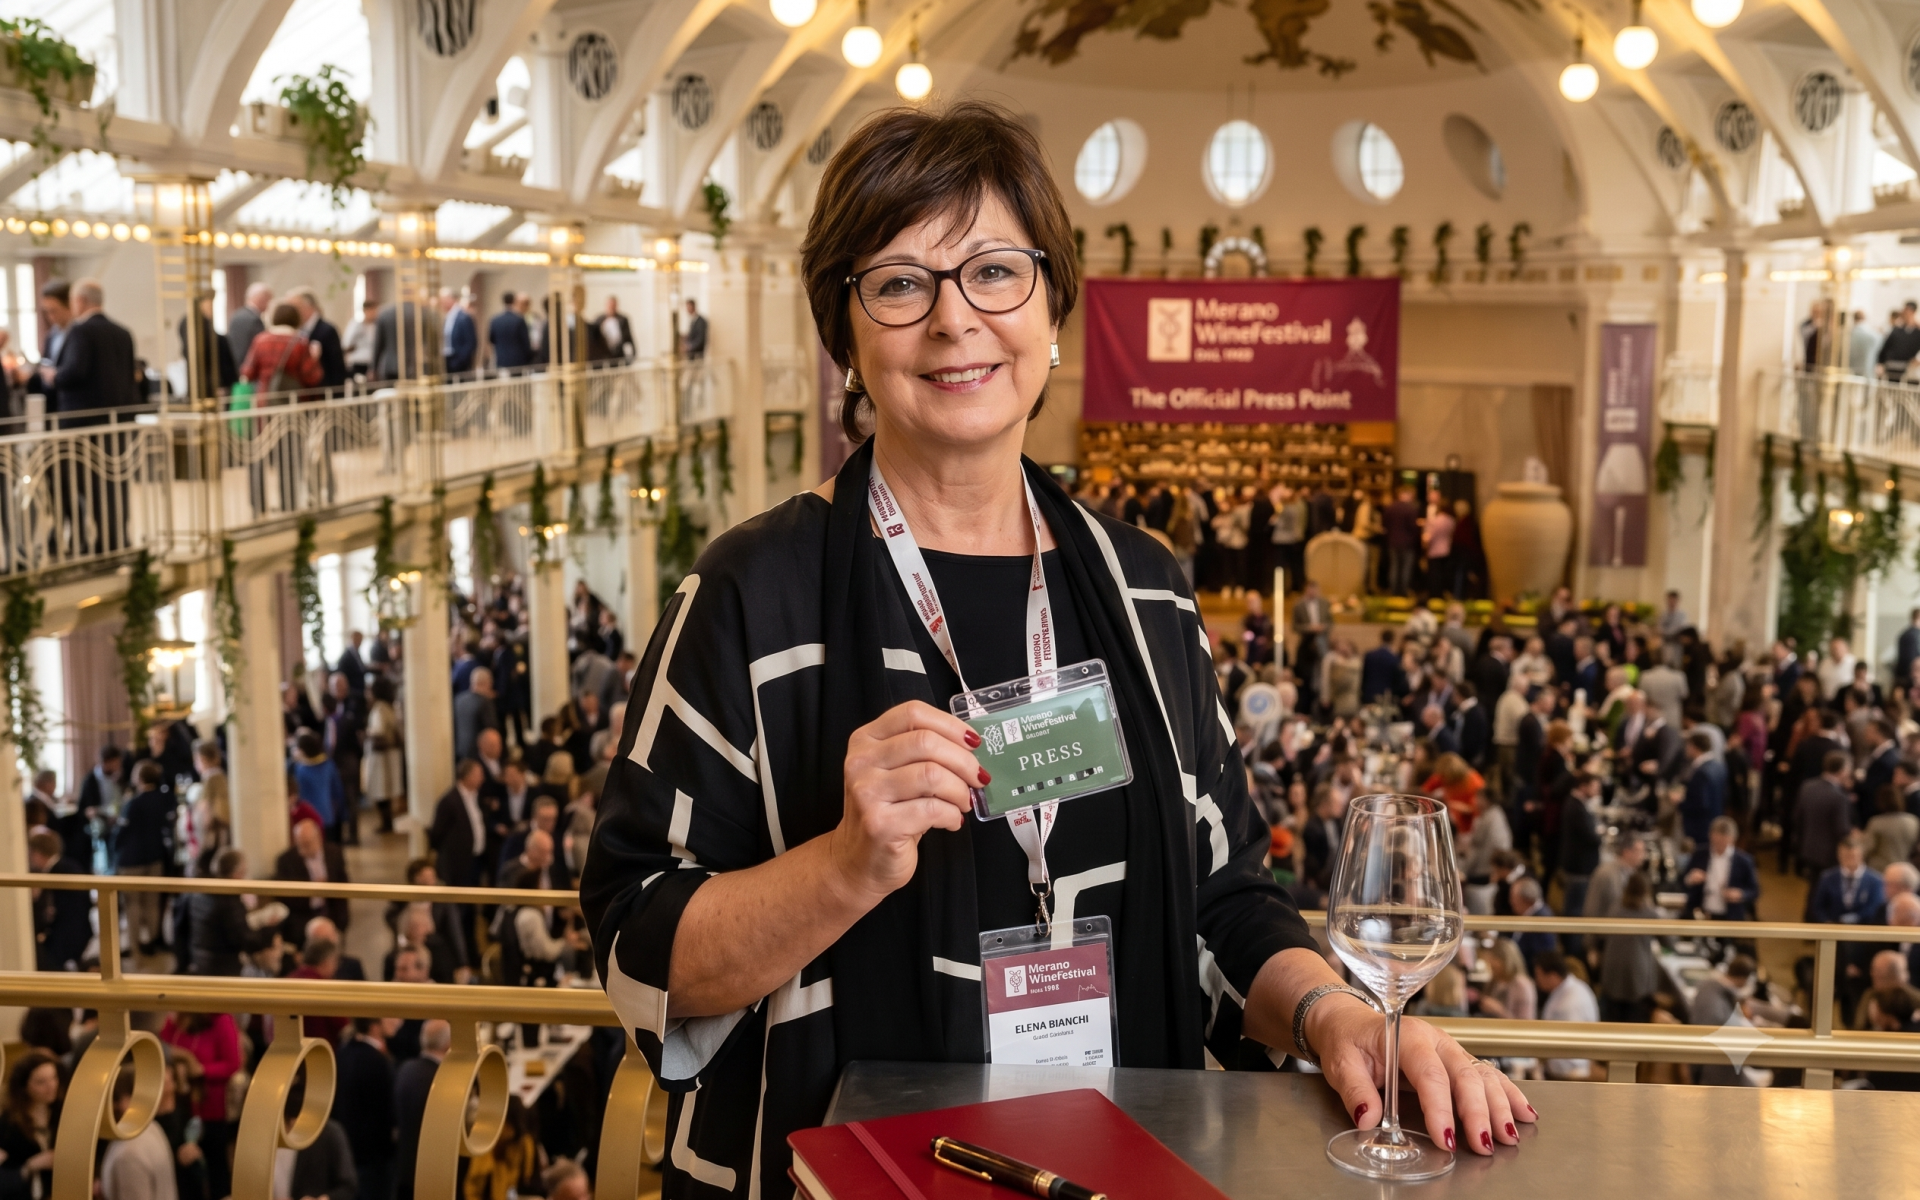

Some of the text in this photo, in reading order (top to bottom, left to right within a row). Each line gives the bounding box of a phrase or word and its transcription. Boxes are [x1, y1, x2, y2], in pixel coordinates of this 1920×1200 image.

[1195, 298, 1279, 321] Merano
[1194, 319, 1331, 344] WineFestival
[1129, 387, 1352, 410] The Official Press Point
[1018, 741, 1083, 771] PRESS
[1028, 961, 1070, 974] Merano
[1029, 966, 1096, 985] WineFestival
[1015, 1022, 1047, 1034] ELENA
[1049, 1015, 1089, 1029] BIANCHI
